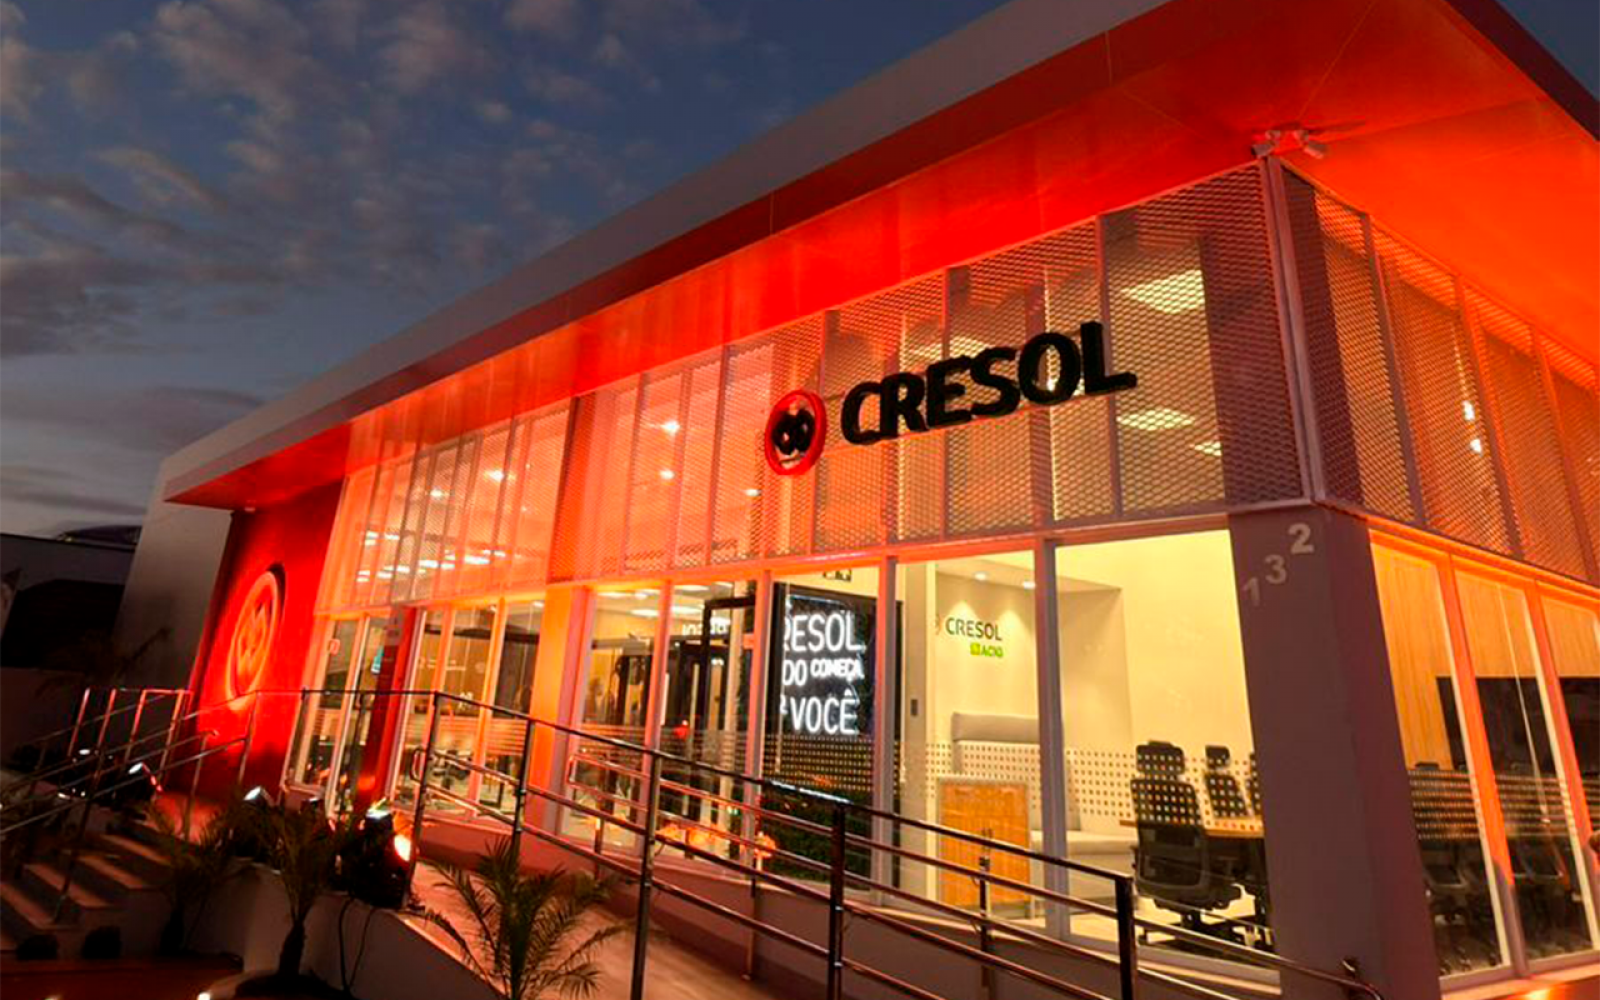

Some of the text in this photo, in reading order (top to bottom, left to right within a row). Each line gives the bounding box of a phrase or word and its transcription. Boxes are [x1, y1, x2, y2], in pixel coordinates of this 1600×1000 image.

[841, 321, 1137, 445] CRESOL
[1243, 523, 1315, 607] 132
[945, 617, 1003, 641] CRESOL
[810, 658, 865, 683] COMEÇA
[790, 688, 860, 735] VOCÊ
